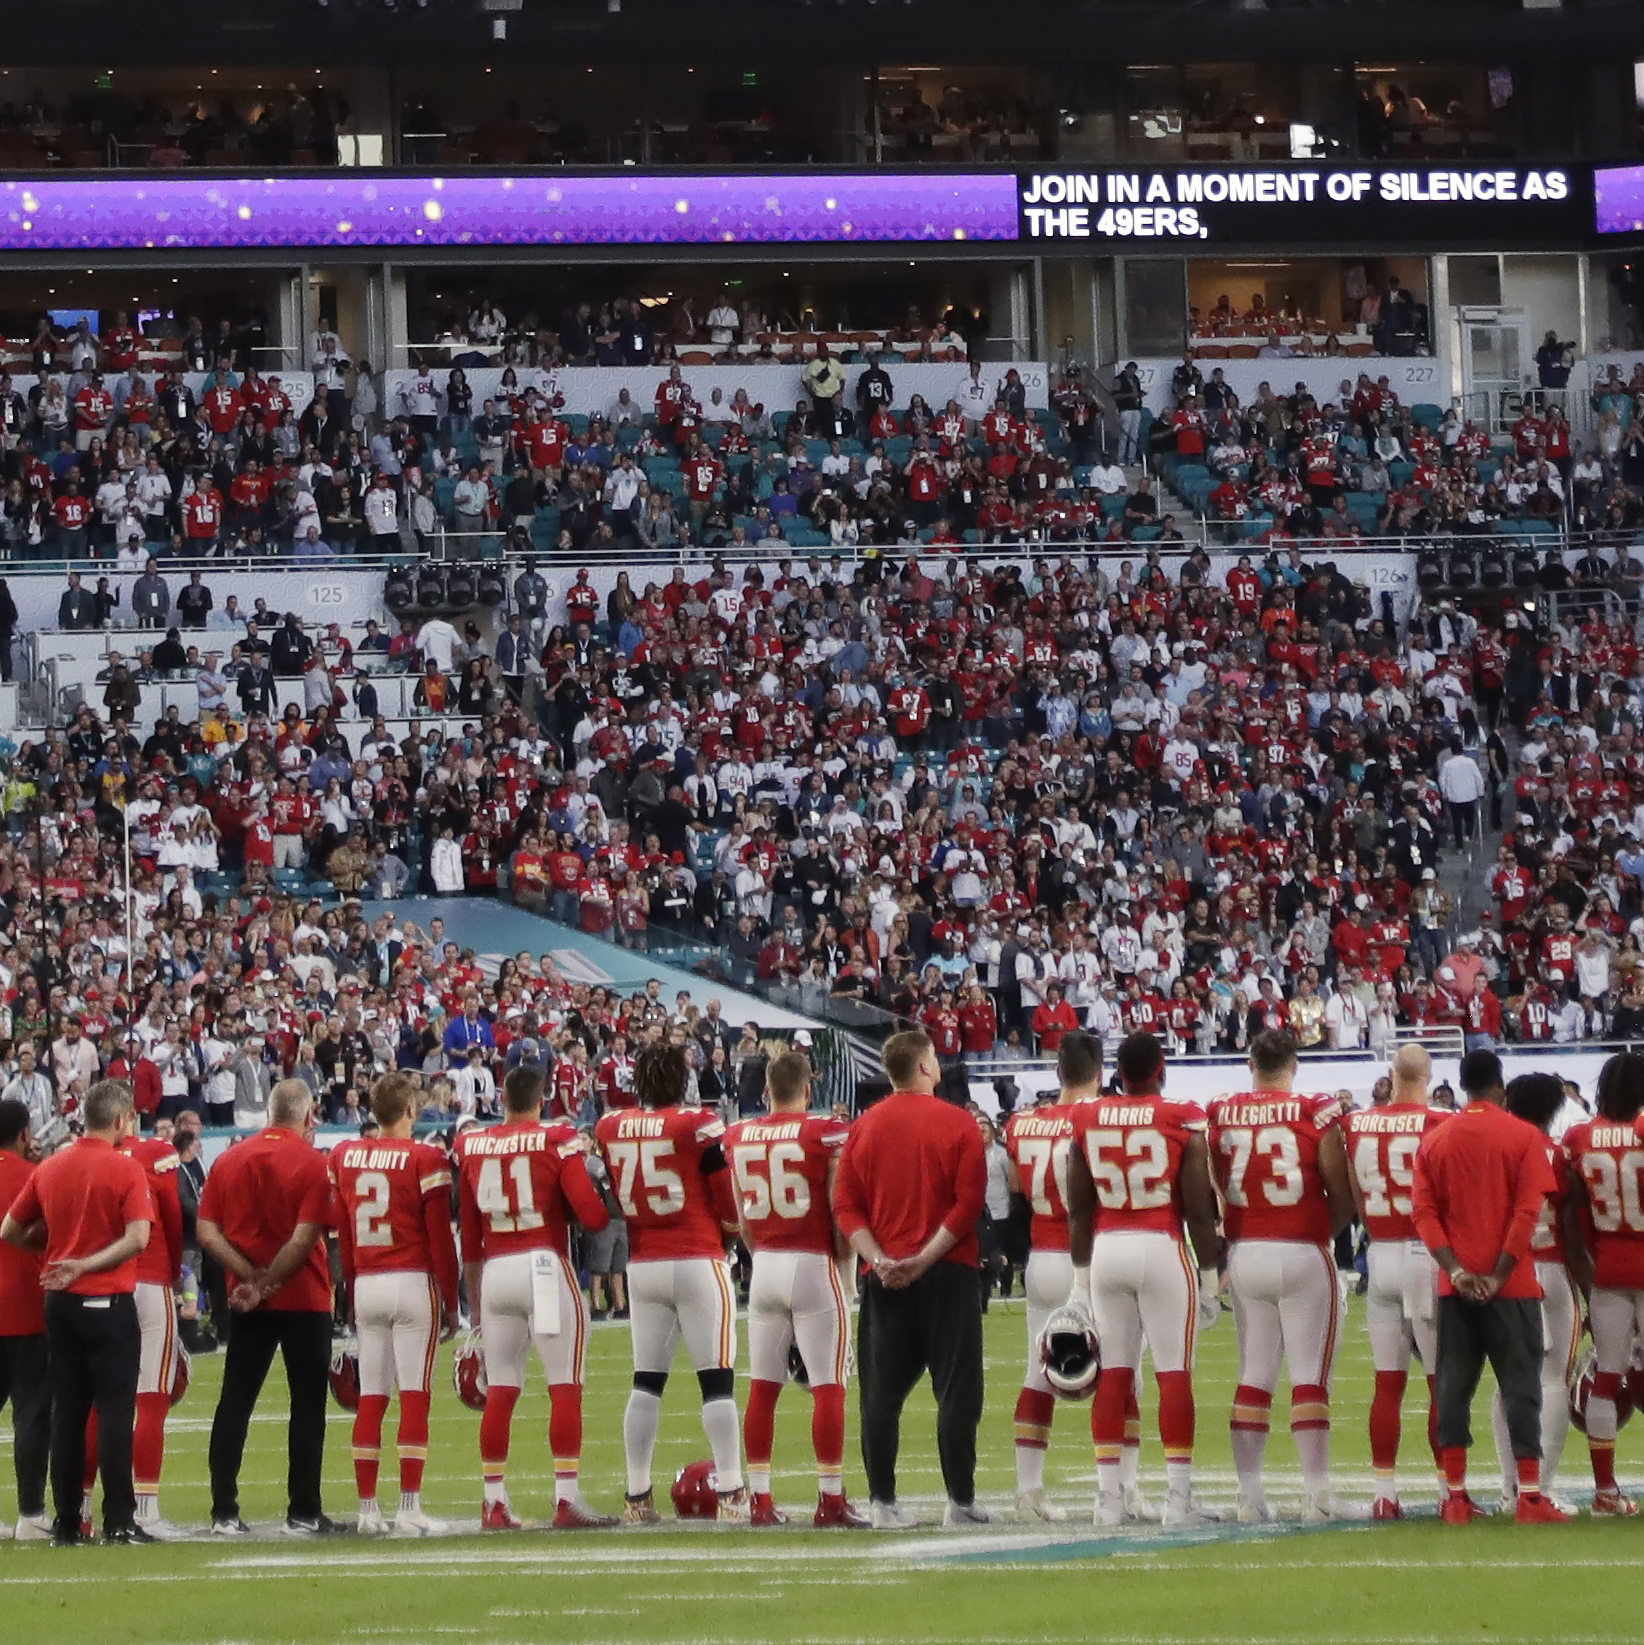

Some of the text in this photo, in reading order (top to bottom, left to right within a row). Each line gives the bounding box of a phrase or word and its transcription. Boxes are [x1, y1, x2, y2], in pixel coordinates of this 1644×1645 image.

[1023, 170, 1568, 204] JOIN IN A MOMENT OF SILENCE AS
[1023, 206, 1208, 239] THE 49ERS,
[1023, 372, 1042, 390] 26
[1139, 368, 1154, 383] 27
[1405, 366, 1434, 383] 227
[1596, 365, 1623, 379] 28
[282, 383, 304, 399] 25
[867, 382, 883, 397] 13
[216, 393, 233, 409] 15
[541, 428, 557, 445] 15
[1370, 567, 1397, 584] 126
[311, 585, 342, 604] 125
[1237, 582, 1255, 600] 19
[722, 596, 739, 612] 15
[1171, 751, 1193, 767] 85
[1551, 941, 1572, 959] 29
[1526, 1002, 1544, 1020] 10
[1098, 1105, 1154, 1125] HARRIS
[1217, 1101, 1301, 1123] ALLEGRETTI
[617, 1118, 663, 1137] ERVING
[740, 1122, 800, 1141] NIEMANN
[1350, 1112, 1425, 1133] SORENSEN
[464, 1132, 546, 1154] WINCHESTER
[1591, 1128, 1638, 1148] BROW
[343, 1151, 409, 1170] COLQUITT
[1224, 1127, 1303, 1208] 73
[607, 1141, 685, 1216] 75
[1086, 1130, 1172, 1211] 52
[1354, 1135, 1415, 1216] 49
[732, 1144, 810, 1220] 56
[476, 1157, 544, 1233] 41
[355, 1173, 392, 1246] 2
